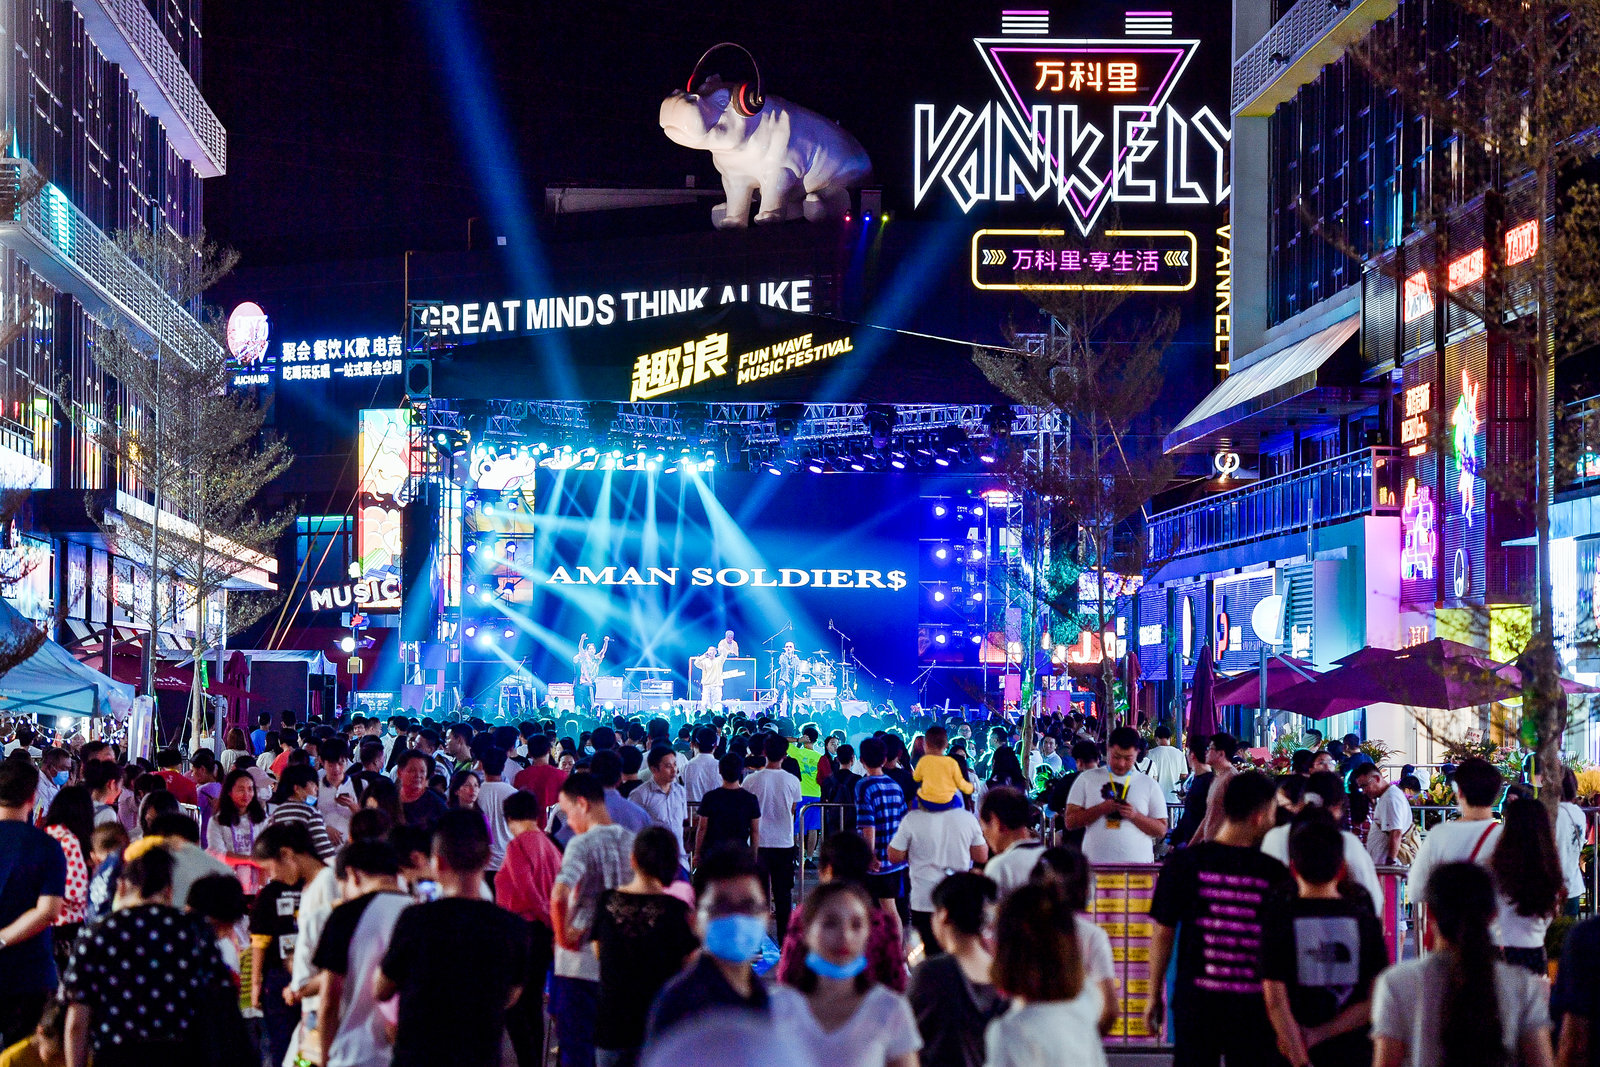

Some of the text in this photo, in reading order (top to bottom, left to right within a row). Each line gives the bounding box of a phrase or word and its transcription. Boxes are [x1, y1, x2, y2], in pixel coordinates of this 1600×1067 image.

[1034, 61, 1138, 93] 万科里
[1012, 249, 1159, 272] 万科里·享生活
[421, 301, 520, 336] GREAT
[526, 294, 615, 330] MINDS
[621, 287, 708, 321] THINK
[282, 335, 402, 364] 聚会 餐饮 K歌 电竞
[737, 336, 854, 386] MUSIC FESTIVAL
[738, 334, 814, 368] FUN WAVE
[233, 373, 269, 386] JUCHANG
[629, 332, 729, 403] 趣浪
[310, 578, 400, 611] MUSIC
[546, 565, 908, 592] AMAN SOLDIER$
